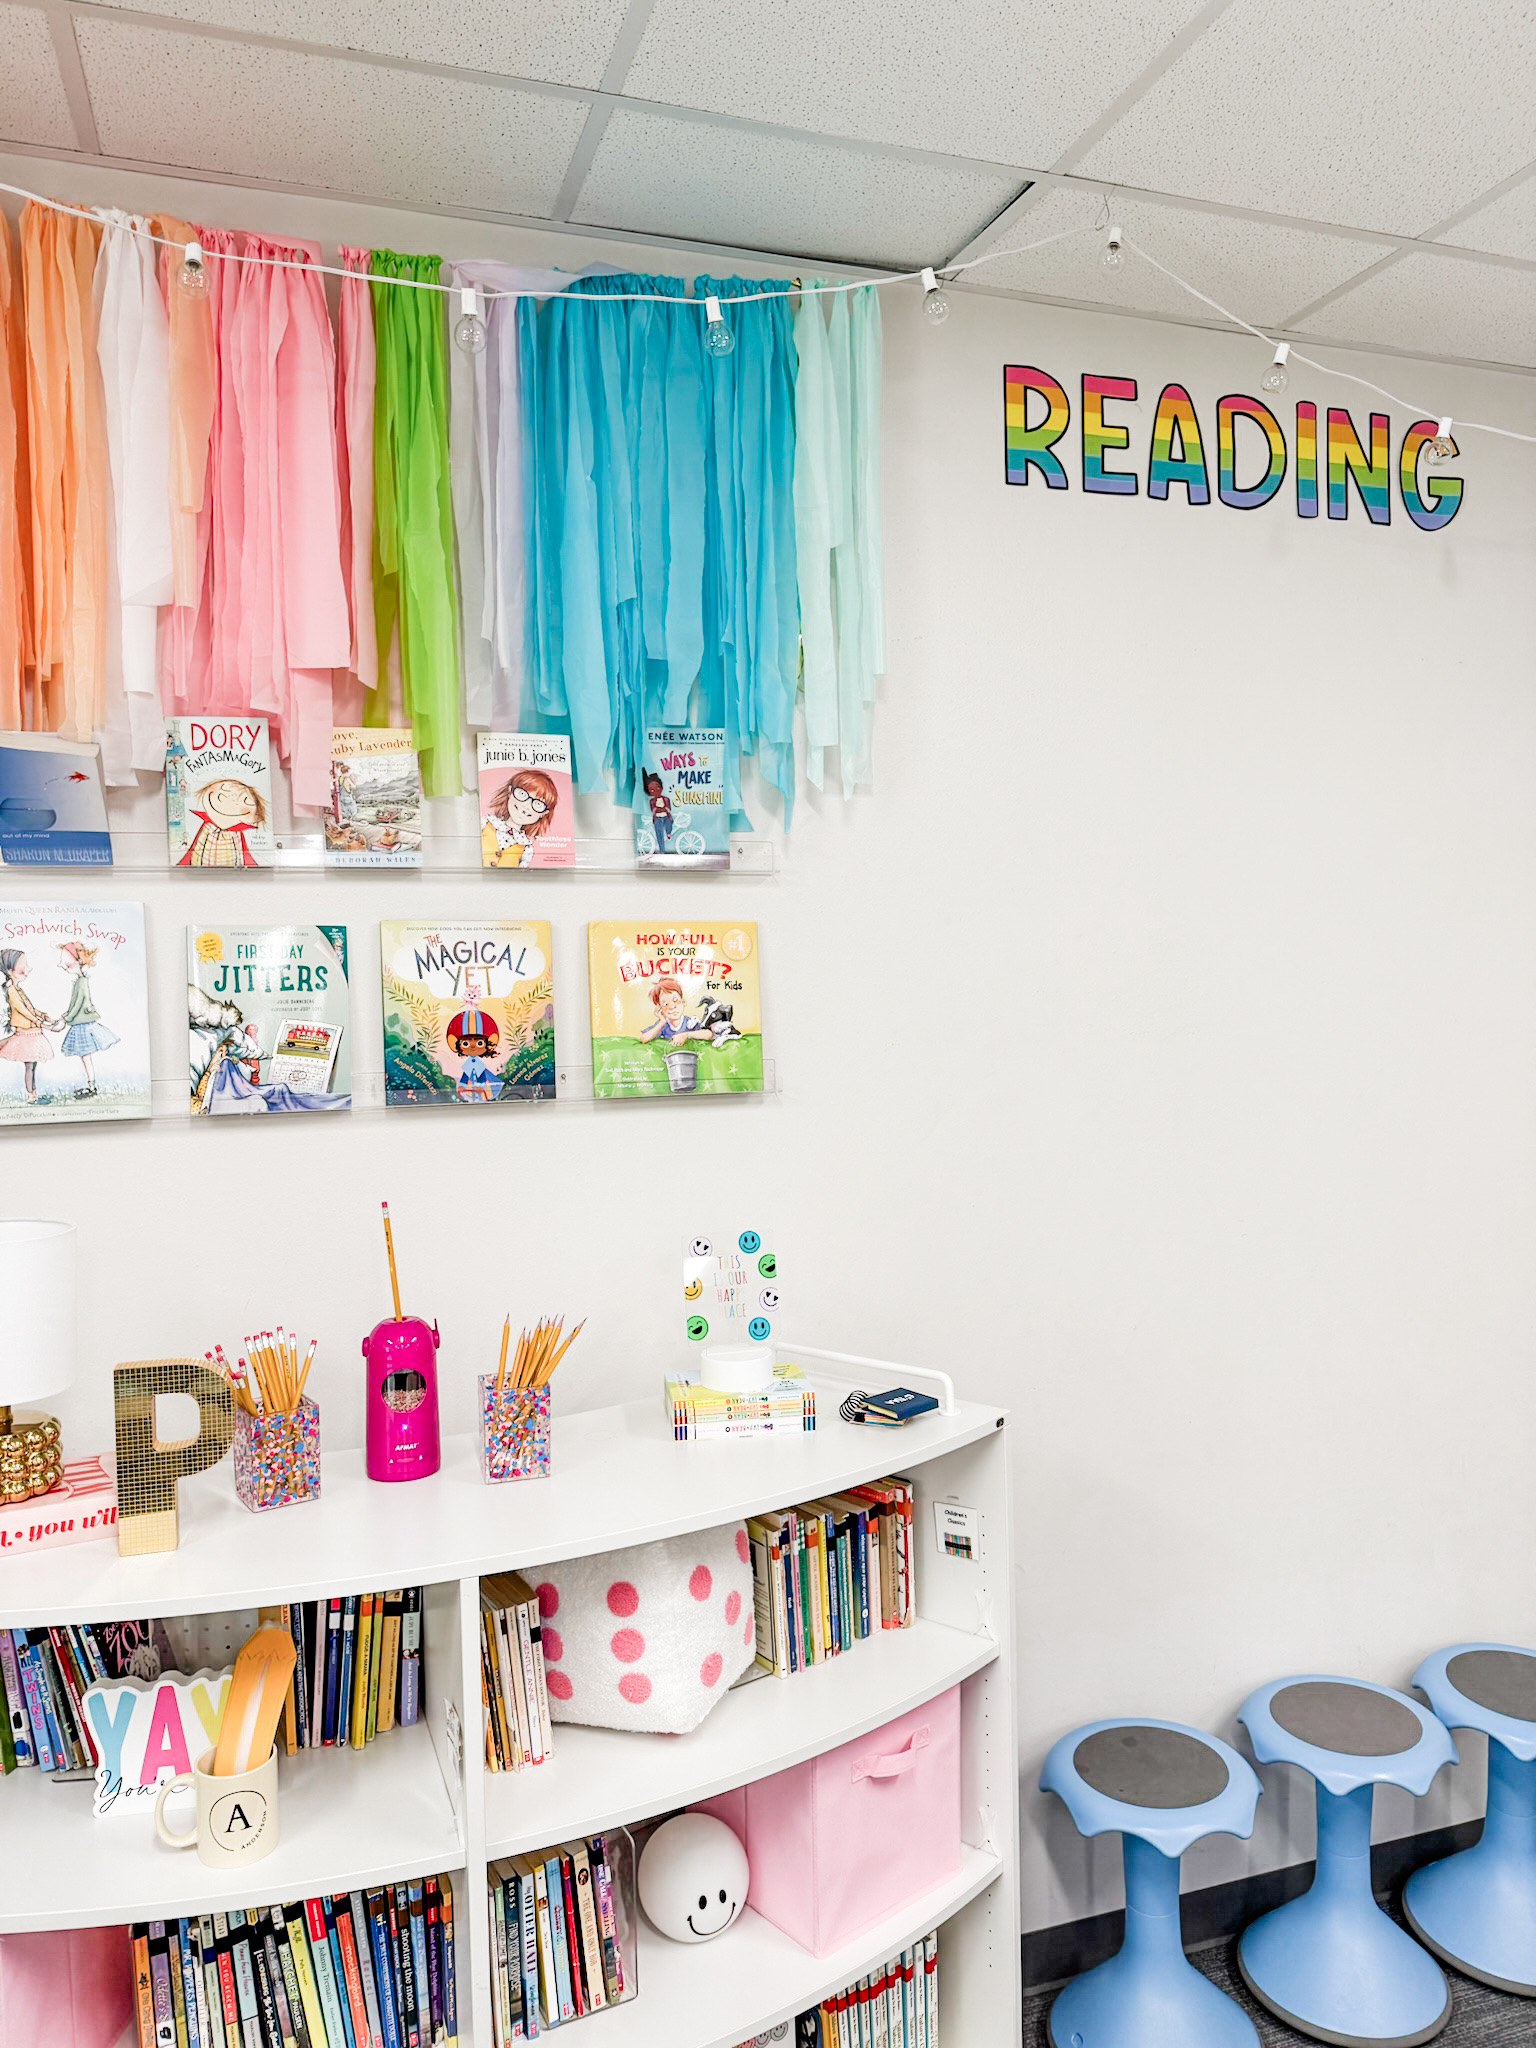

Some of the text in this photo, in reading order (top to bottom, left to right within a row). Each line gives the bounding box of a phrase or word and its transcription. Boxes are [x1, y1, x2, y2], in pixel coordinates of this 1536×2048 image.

[1003, 364, 1465, 532] READING
[190, 723, 261, 751] DORY
[331, 738, 412, 756] uby Lavender
[332, 732, 358, 741] ove,
[648, 731, 724, 741] ENÉE WATSON
[483, 748, 567, 766] junie b. jones
[660, 750, 696, 771] WAYS
[678, 771, 712, 789] MAKE
[6, 848, 51, 861] SHARON
[25, 907, 53, 915] QUEEN
[4, 919, 127, 950] Sandwich Swap
[424, 934, 442, 948] THE
[636, 935, 717, 945] HOW FULL
[728, 934, 745, 951] #1
[414, 941, 527, 979] MAGICAL
[657, 948, 696, 956] IS YOUR
[214, 965, 329, 993] JITTERS
[446, 966, 495, 996] YET
[620, 958, 732, 982] BUCKET?
[706, 981, 743, 990] For Kids
[727, 1270, 748, 1286] OUR
[717, 1287, 742, 1303] HAPP
[721, 1303, 747, 1320] LACE
[28, 1506, 118, 1543] you wil
[944, 1509, 968, 1519] Children's
[522, 1638, 532, 1675] GENTLE
[22, 1668, 43, 1730] TWINS
[99, 1768, 190, 1813] You'
[224, 1804, 253, 1833] A
[241, 1810, 267, 1850] ANDERSON
[508, 1881, 516, 1909] ROSS
[582, 1897, 590, 1911] THE
[583, 1911, 592, 1924] ONE
[508, 1922, 518, 1939] FIND
[524, 1895, 536, 1973] OTTER HALF
[585, 1924, 594, 1937] AND
[509, 1939, 519, 1958] YOUR
[586, 1937, 596, 1954] ONLY
[237, 1943, 252, 1996] Penny from Heaven
[318, 1945, 328, 1974] Johnny
[323, 1974, 333, 2002] Tremain
[345, 1945, 364, 2007] mockingbird
[363, 1959, 374, 1995] Rascal
[401, 1929, 414, 2011] shooting the moon
[155, 1976, 170, 2011] Odette's
[224, 1985, 232, 2009] REACH
[282, 1951, 303, 2029] HATCHET PAULSEN
[198, 1999, 206, 2026] YELLER
[227, 2012, 233, 2022] ME
